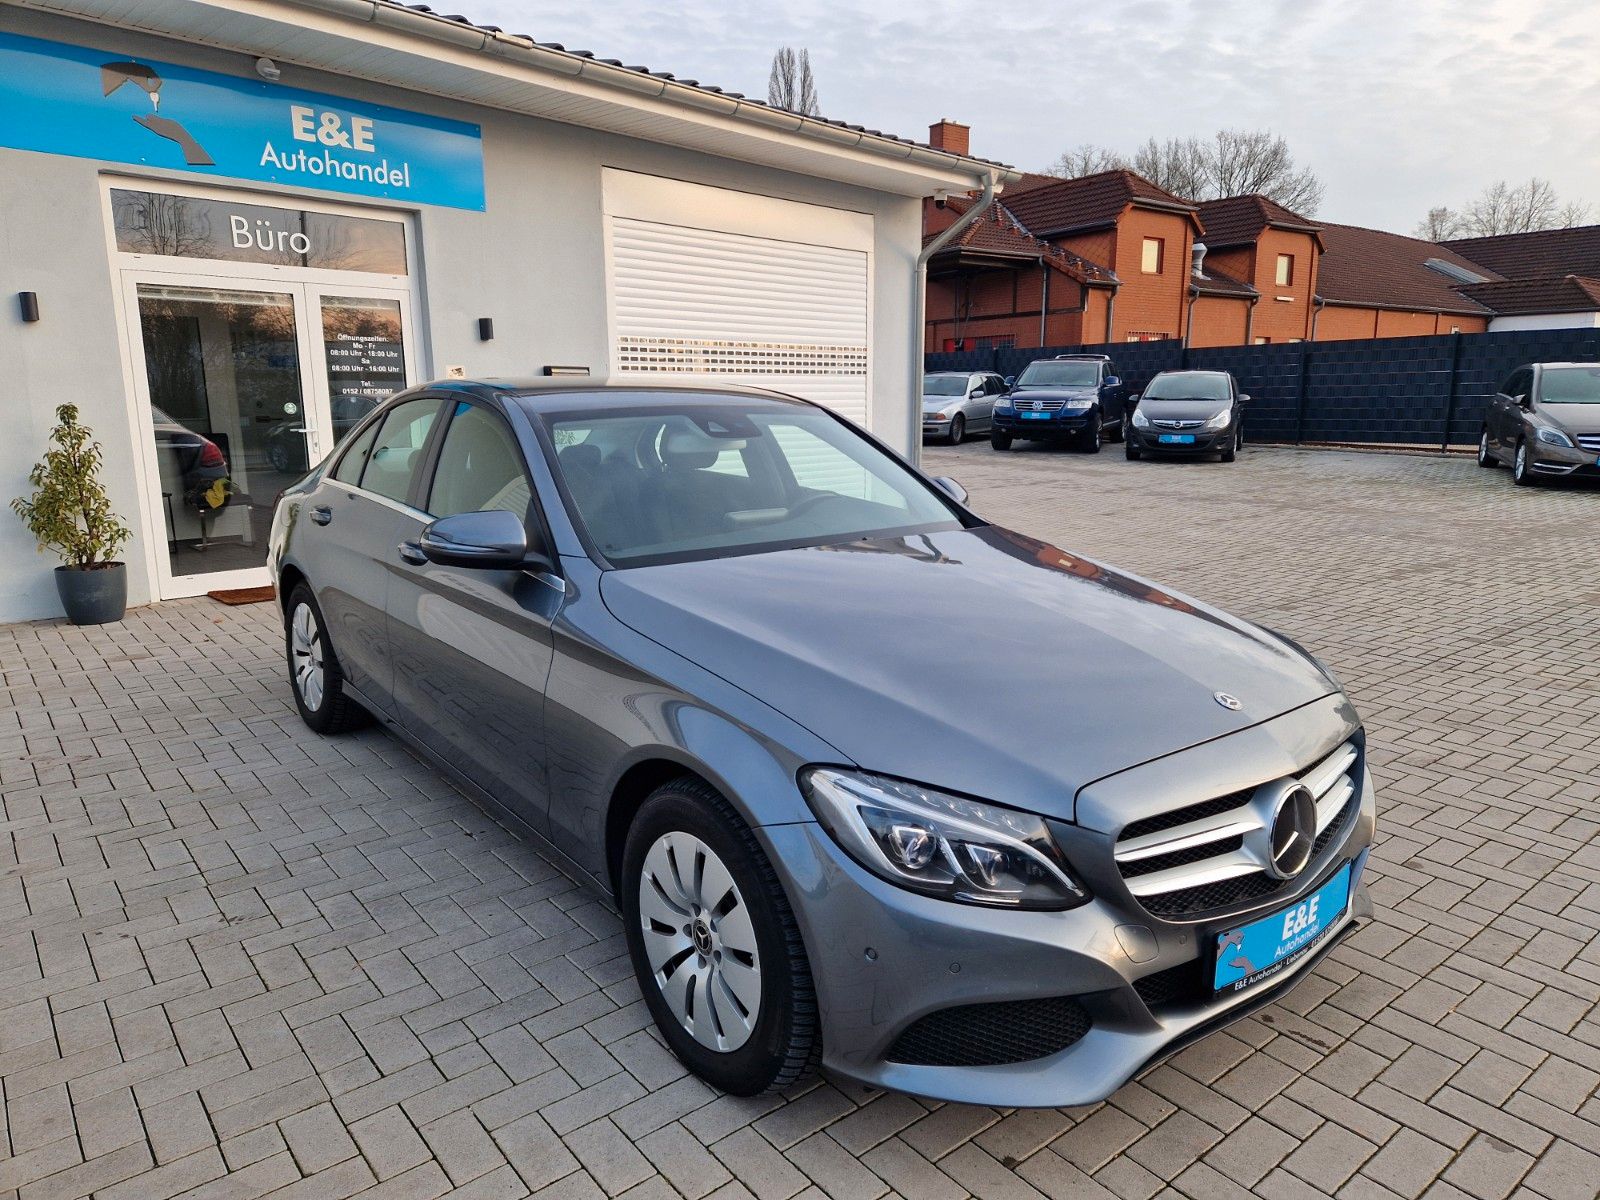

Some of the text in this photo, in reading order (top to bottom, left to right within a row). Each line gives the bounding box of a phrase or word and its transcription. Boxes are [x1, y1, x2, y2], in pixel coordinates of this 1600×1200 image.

[291, 105, 375, 153] E&E
[260, 141, 410, 188] Autohandel
[230, 215, 311, 254] Büro
[1281, 895, 1320, 941] E&E
[1273, 920, 1320, 959] Autohandel
[1234, 962, 1283, 991] E&E Autohandel
